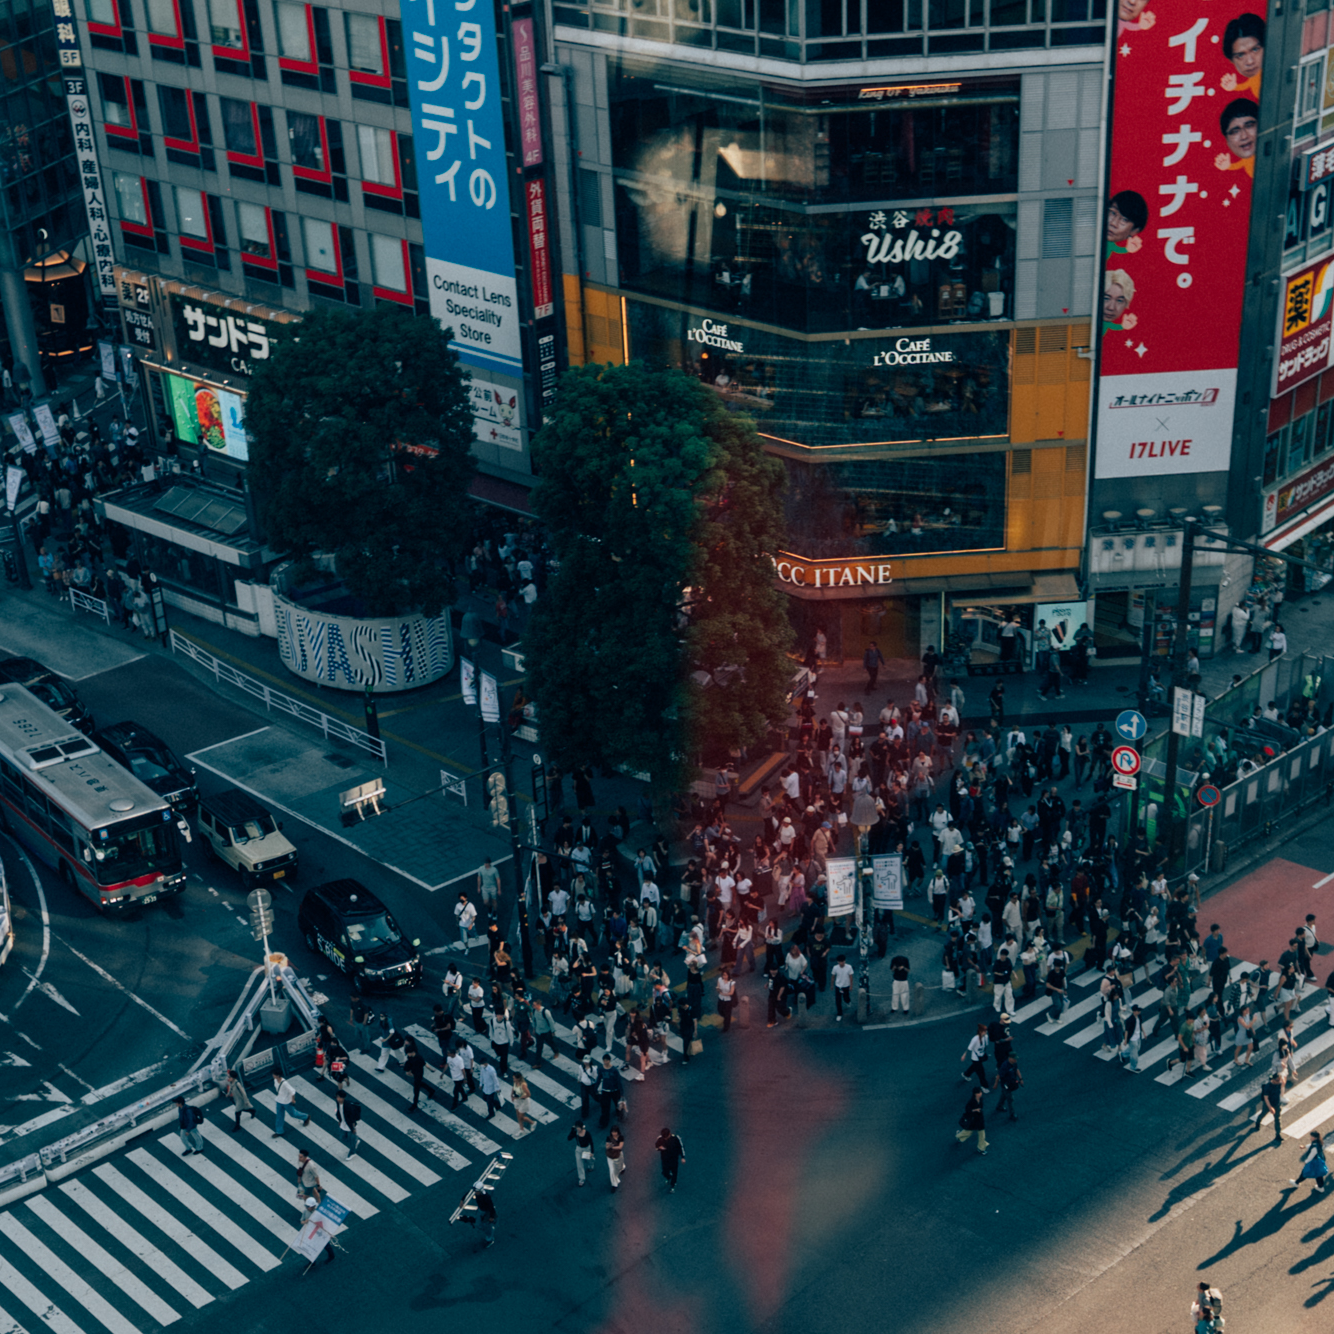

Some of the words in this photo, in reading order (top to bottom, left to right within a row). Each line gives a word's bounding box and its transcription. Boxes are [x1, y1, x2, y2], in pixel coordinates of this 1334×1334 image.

[63, 51, 78, 63] 5F
[67, 81, 83, 94] 3F
[519, 46, 538, 143] 品川美容外科
[455, 0, 496, 210] タクトの
[75, 122, 93, 152] 内科
[529, 181, 545, 249] 外貨両替
[869, 210, 910, 230] 渋谷
[861, 228, 962, 264] Ushi8
[433, 274, 478, 299] Contact
[482, 287, 512, 317] Lens
[446, 299, 503, 328] Speciality
[538, 306, 551, 317] 7F
[183, 304, 270, 360] サンドラ
[460, 324, 492, 345] Store
[873, 350, 954, 366] L'OCCITANE
[1278, 336, 1330, 382] サンドラッグ
[1129, 438, 1193, 459] 17LIVE
[769, 554, 892, 588] CCITANE
